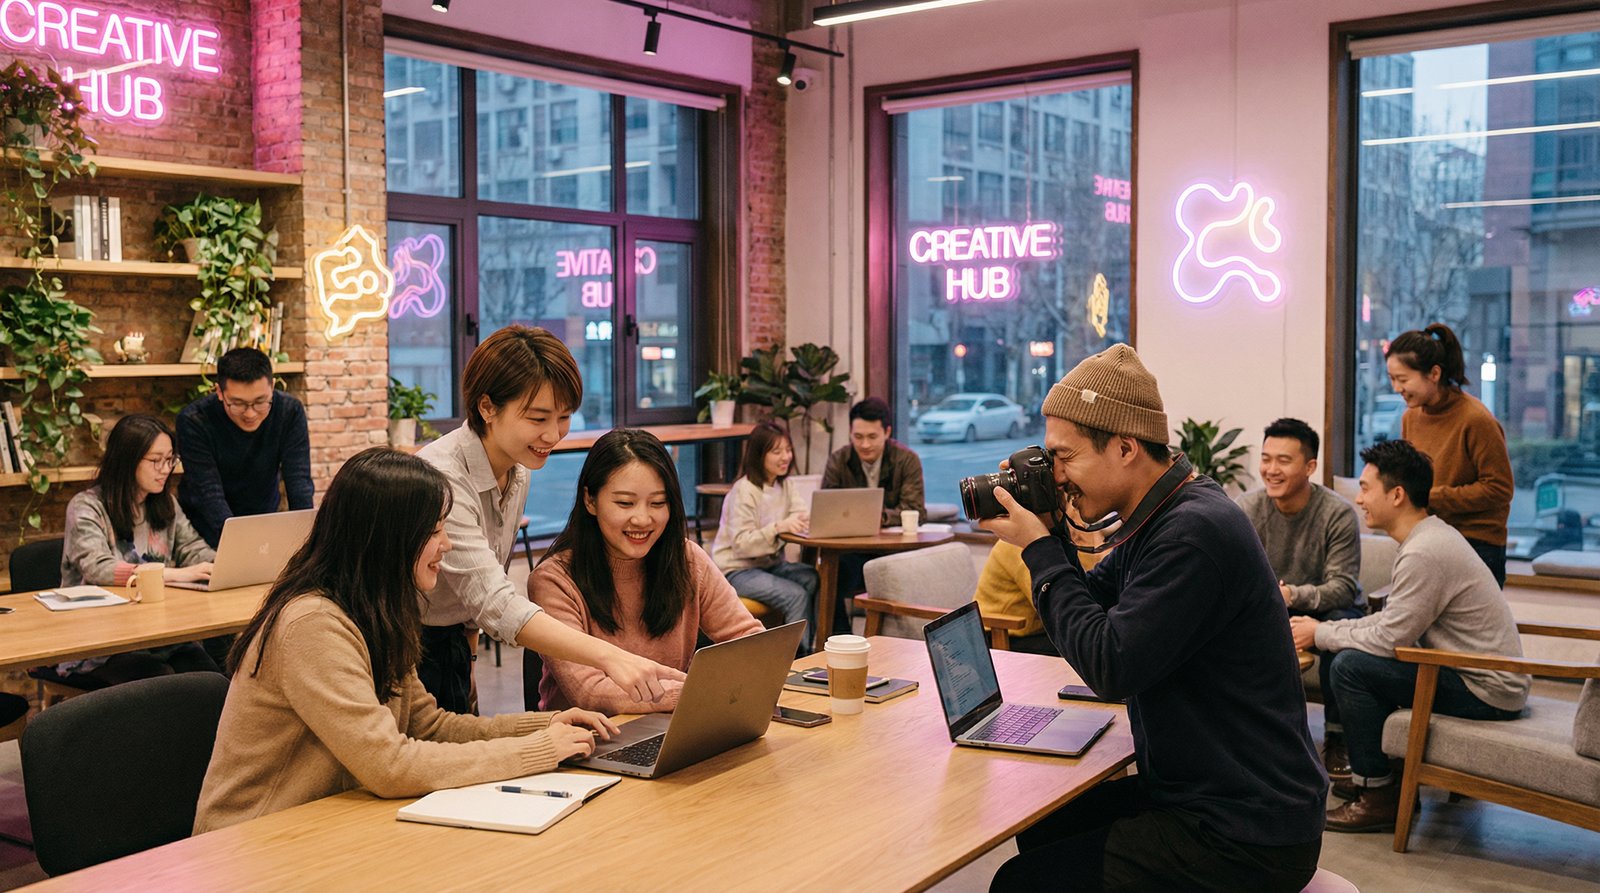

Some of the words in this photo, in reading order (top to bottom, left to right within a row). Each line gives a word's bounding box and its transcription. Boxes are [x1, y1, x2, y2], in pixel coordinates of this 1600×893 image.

[0, 0, 219, 73] CREATIVE
[65, 66, 164, 120] HUB
[909, 223, 1052, 263] CREATIVE
[946, 266, 1010, 300] HUB
